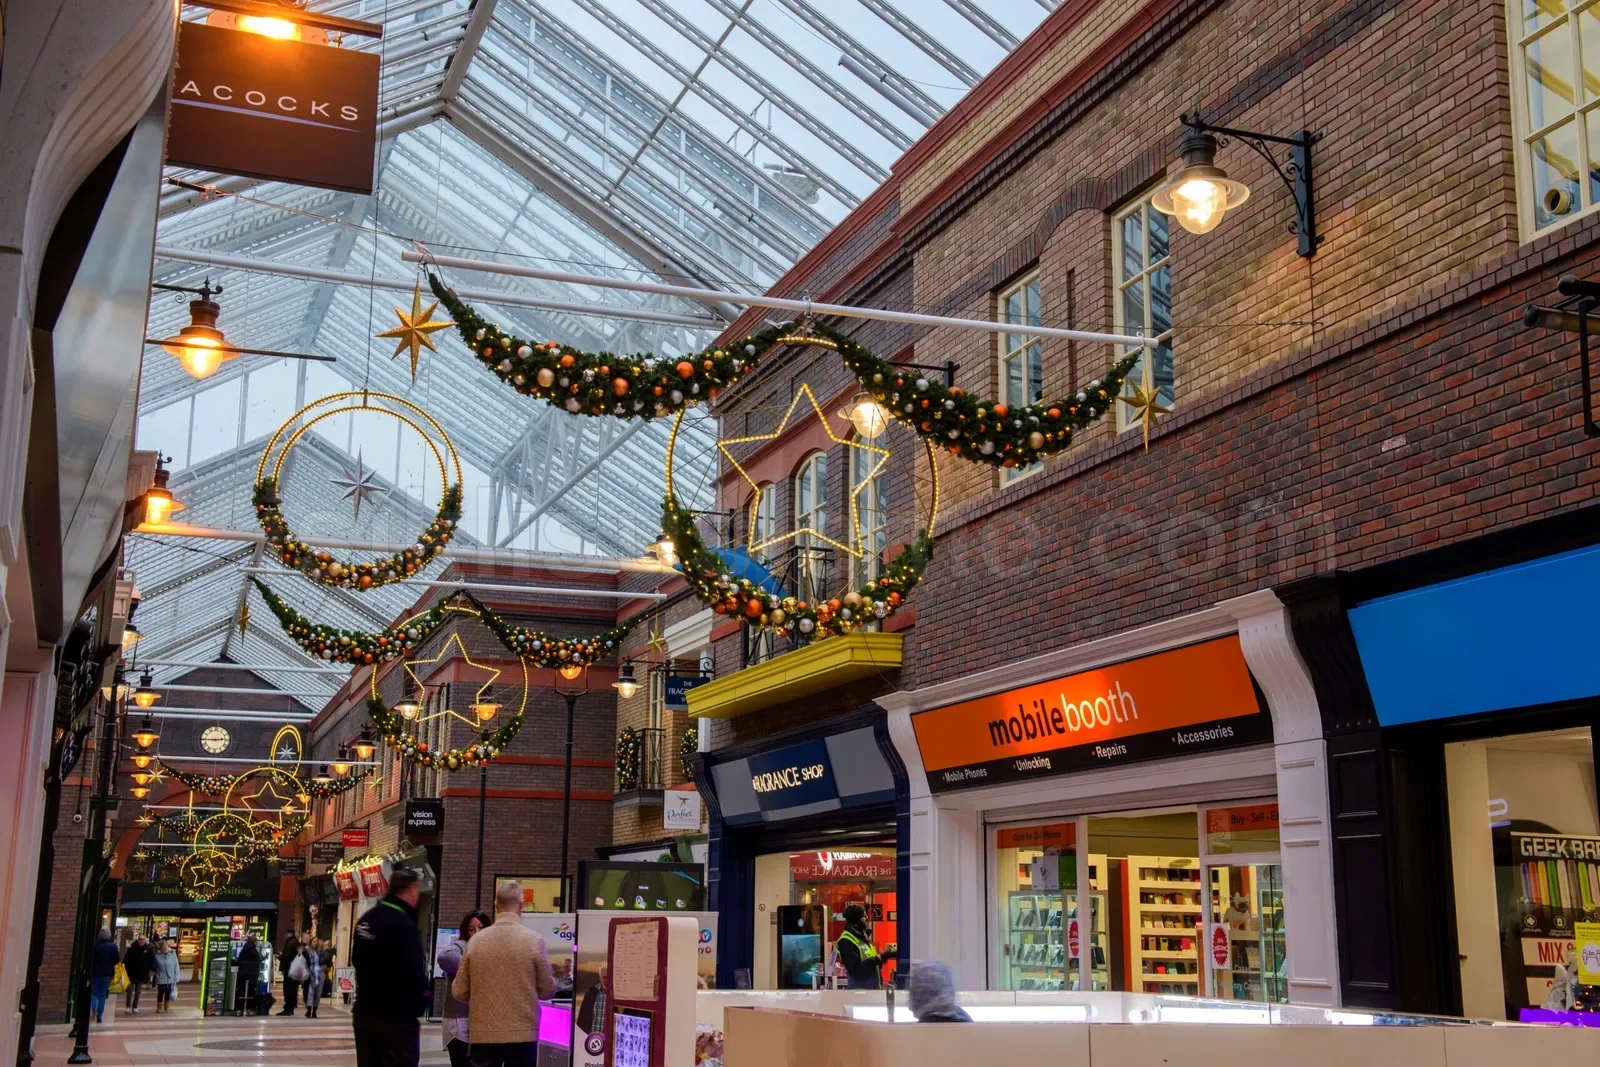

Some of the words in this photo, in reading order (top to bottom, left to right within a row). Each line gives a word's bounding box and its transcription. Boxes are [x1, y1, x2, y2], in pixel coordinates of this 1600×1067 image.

[180, 80, 358, 121] ACOCKS
[988, 681, 1139, 747] mobilebooth
[1177, 725, 1234, 745] Accessories
[1095, 743, 1128, 760] Repairs
[801, 764, 824, 780] SHOP
[1015, 756, 1052, 772] Unlocking
[944, 770, 964, 782] Mobile
[964, 767, 988, 780] Phones
[412, 810, 433, 818] vision
[1231, 814, 1245, 825] Buy
[1250, 812, 1265, 823] Sell
[1520, 837, 1570, 859] GEEK
[152, 886, 180, 895] Thank
[1537, 941, 1564, 964] MIX
[591, 1040, 600, 1049] 41
